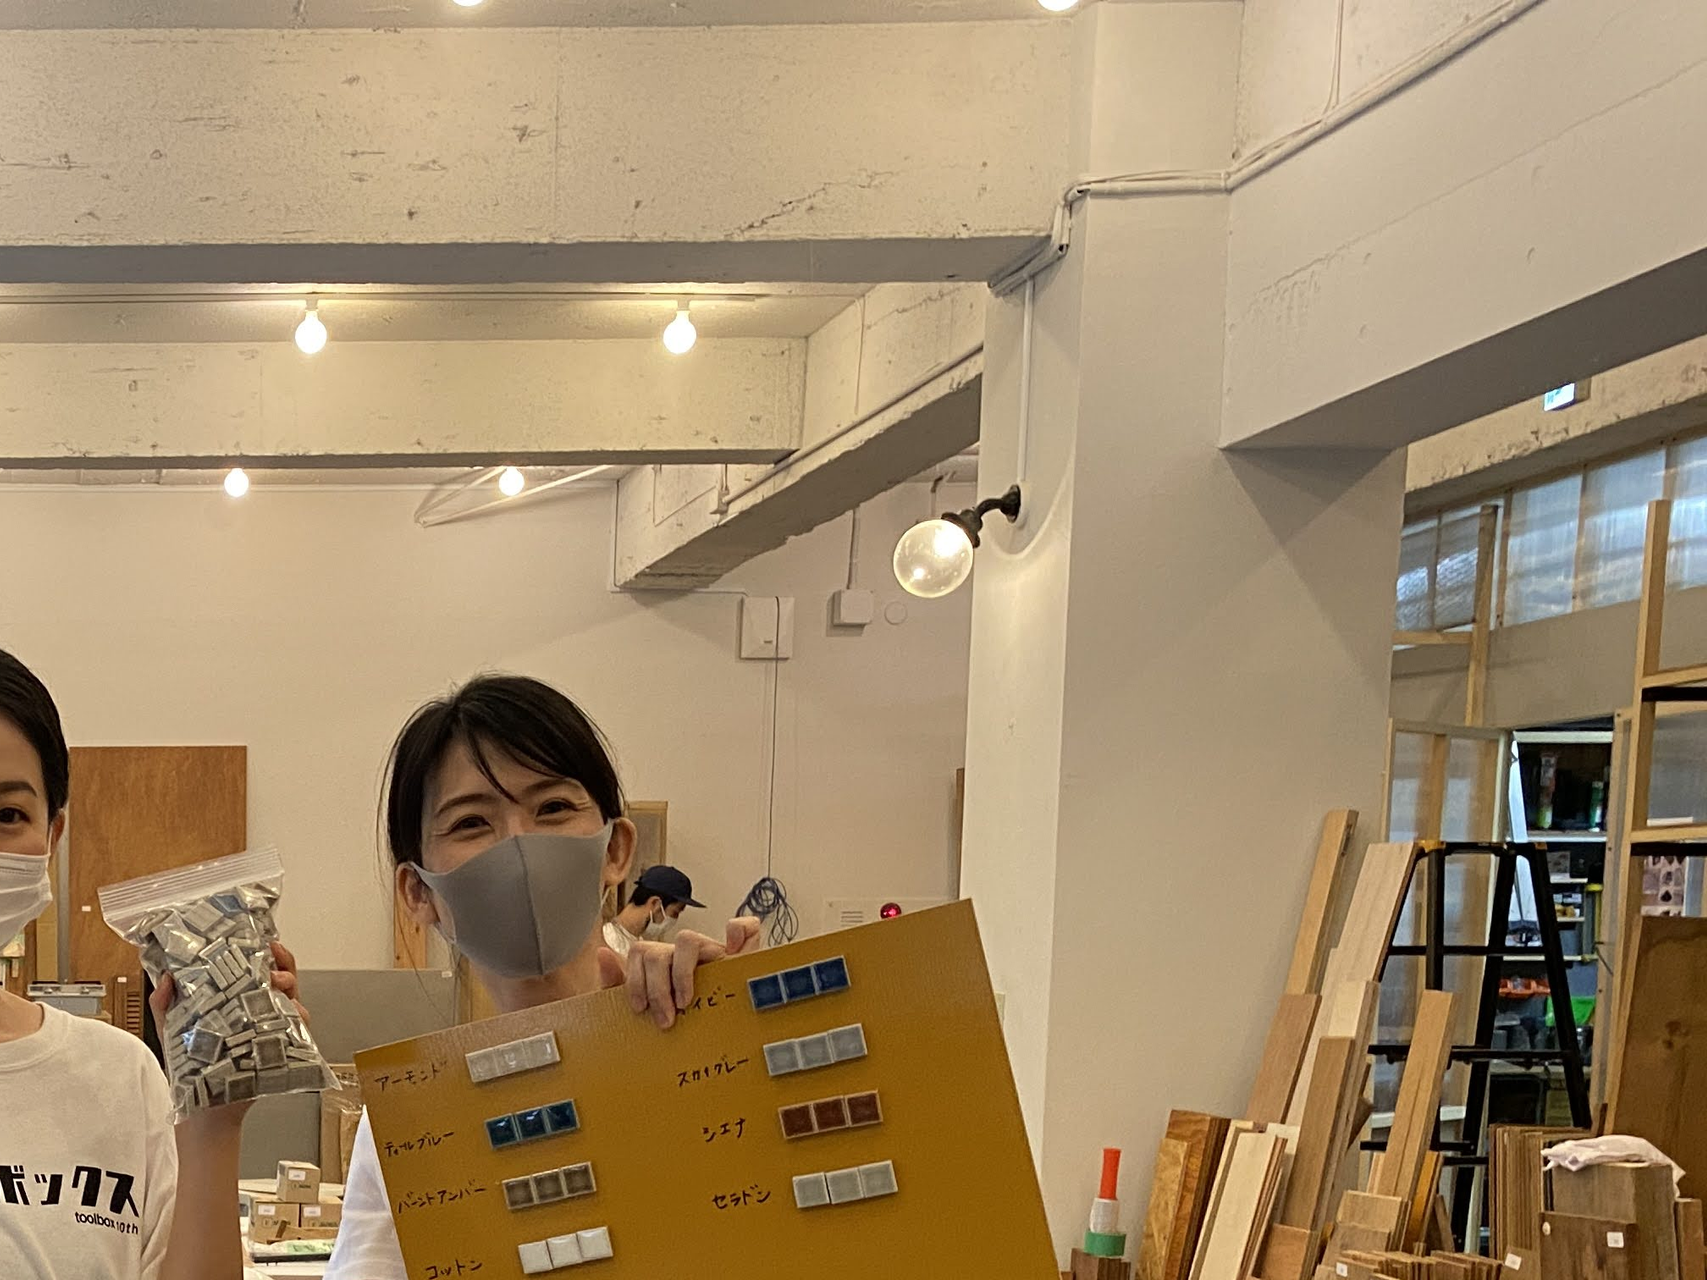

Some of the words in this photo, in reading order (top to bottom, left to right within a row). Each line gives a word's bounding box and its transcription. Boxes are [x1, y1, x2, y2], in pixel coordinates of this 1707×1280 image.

[703, 1117, 746, 1142] シエナ
[712, 1184, 771, 1210] セラドン
[425, 1259, 483, 1280] コットン
